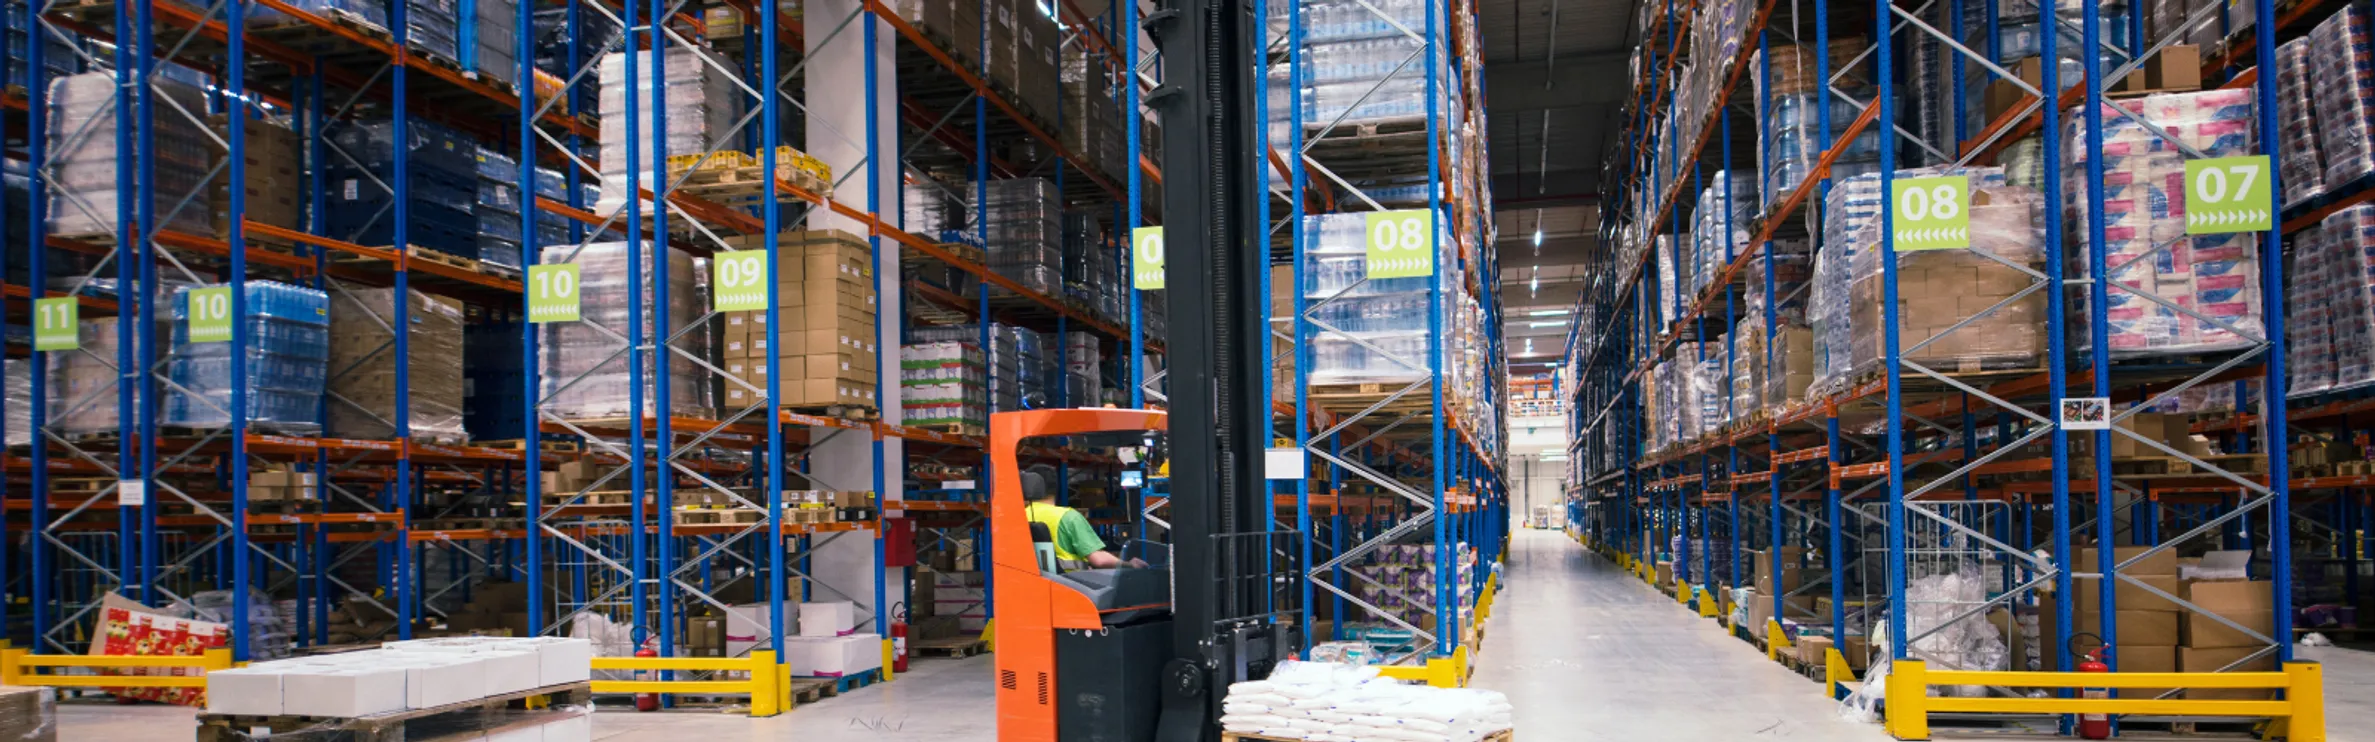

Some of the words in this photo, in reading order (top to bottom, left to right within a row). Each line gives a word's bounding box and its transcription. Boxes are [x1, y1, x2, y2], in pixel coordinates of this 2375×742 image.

[2196, 164, 2259, 203] 07
[1902, 185, 1959, 221] 08
[1141, 234, 1164, 264] 0
[1374, 218, 1425, 252] 08
[536, 270, 574, 298] 10
[721, 257, 760, 287] 09
[40, 304, 69, 329] 11
[195, 294, 227, 320] 10
